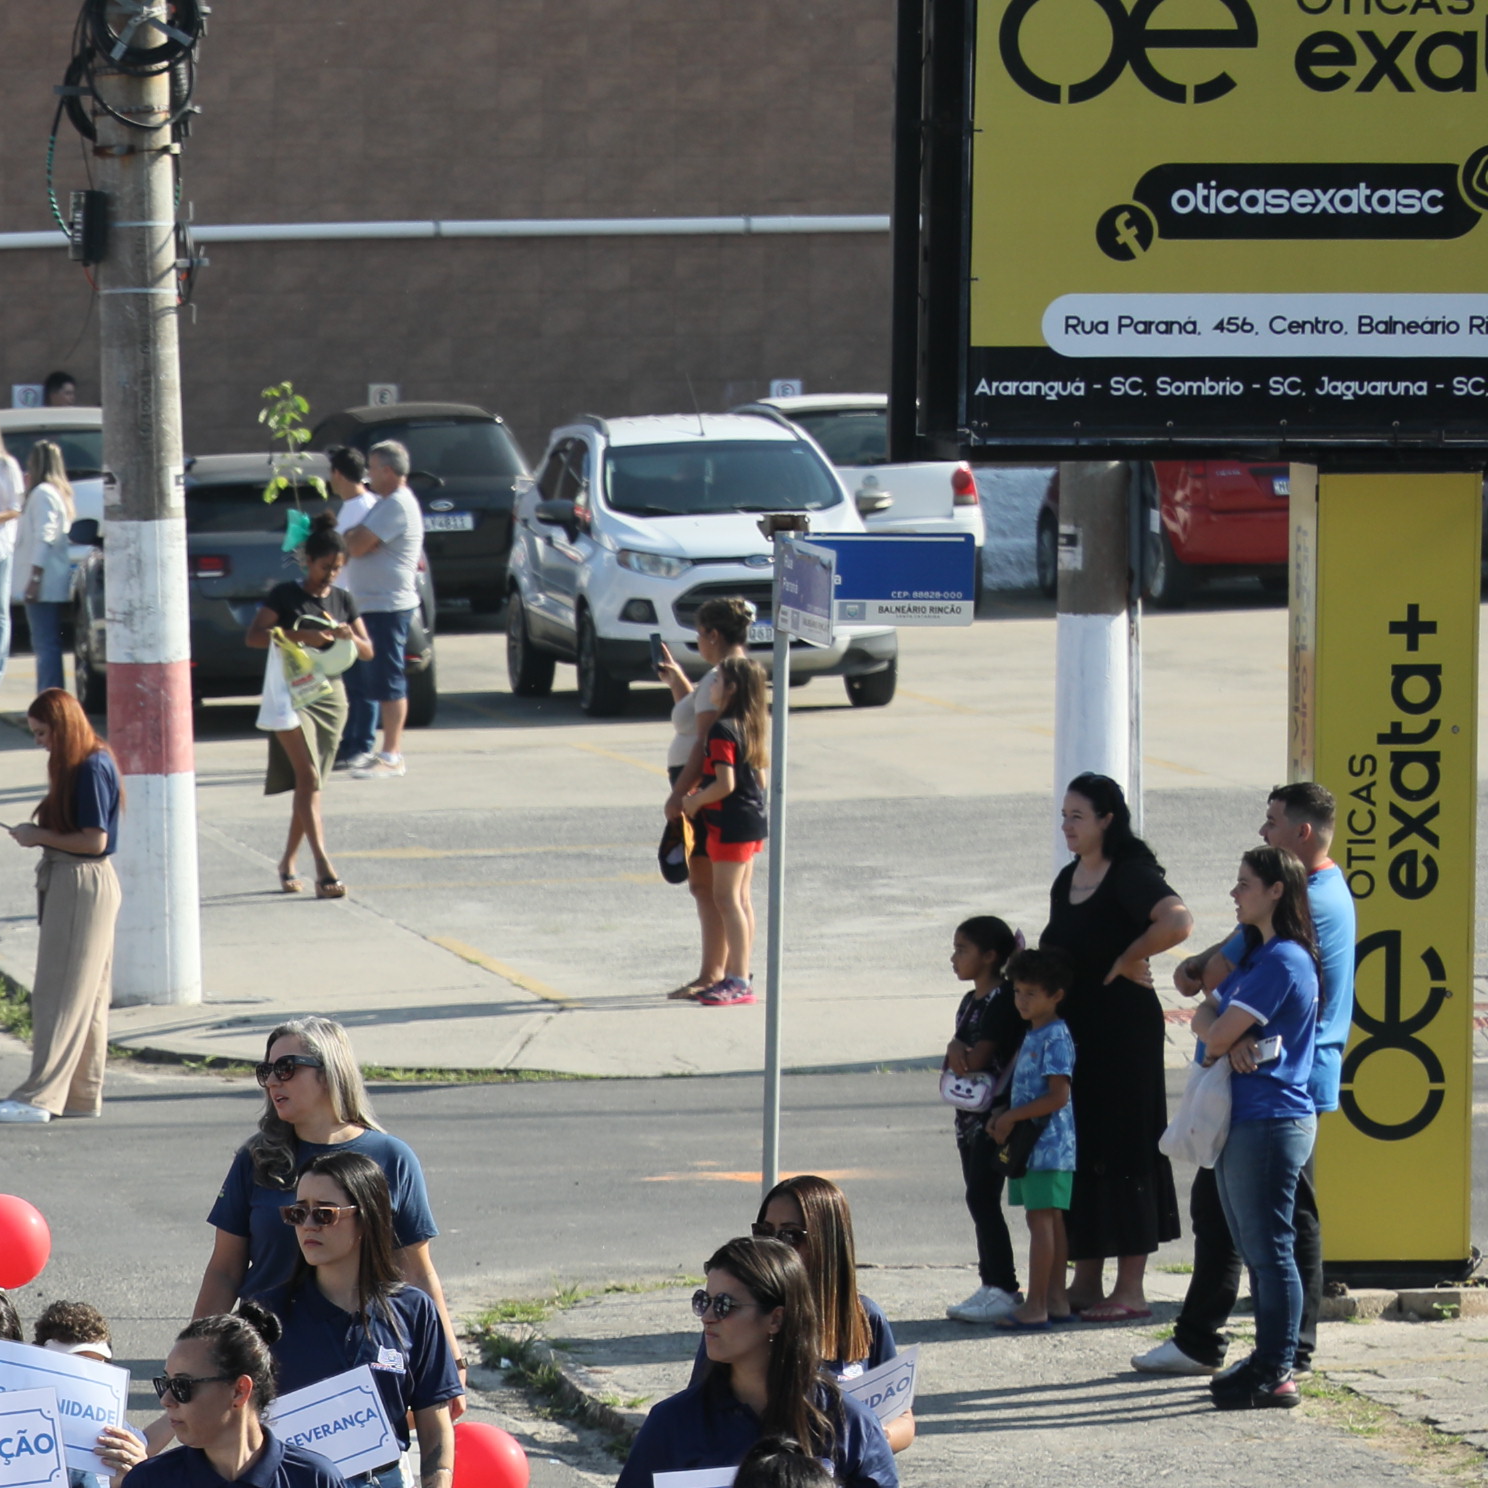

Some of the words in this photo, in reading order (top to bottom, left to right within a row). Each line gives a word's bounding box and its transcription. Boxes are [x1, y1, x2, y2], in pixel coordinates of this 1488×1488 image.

[1171, 180, 1444, 215] oticasexatasc
[1064, 314, 1109, 336] Rua
[1357, 314, 1460, 336] Balneário
[974, 377, 1085, 401] Araranguá
[1156, 376, 1243, 397] Sombrio
[1315, 377, 1427, 401] Jaguaruna
[877, 603, 927, 615] BALNEÁRIO
[928, 603, 962, 614] RINCÃO
[1348, 753, 1378, 900] OTICAS
[285, 1407, 379, 1447] SEVERANÇA
